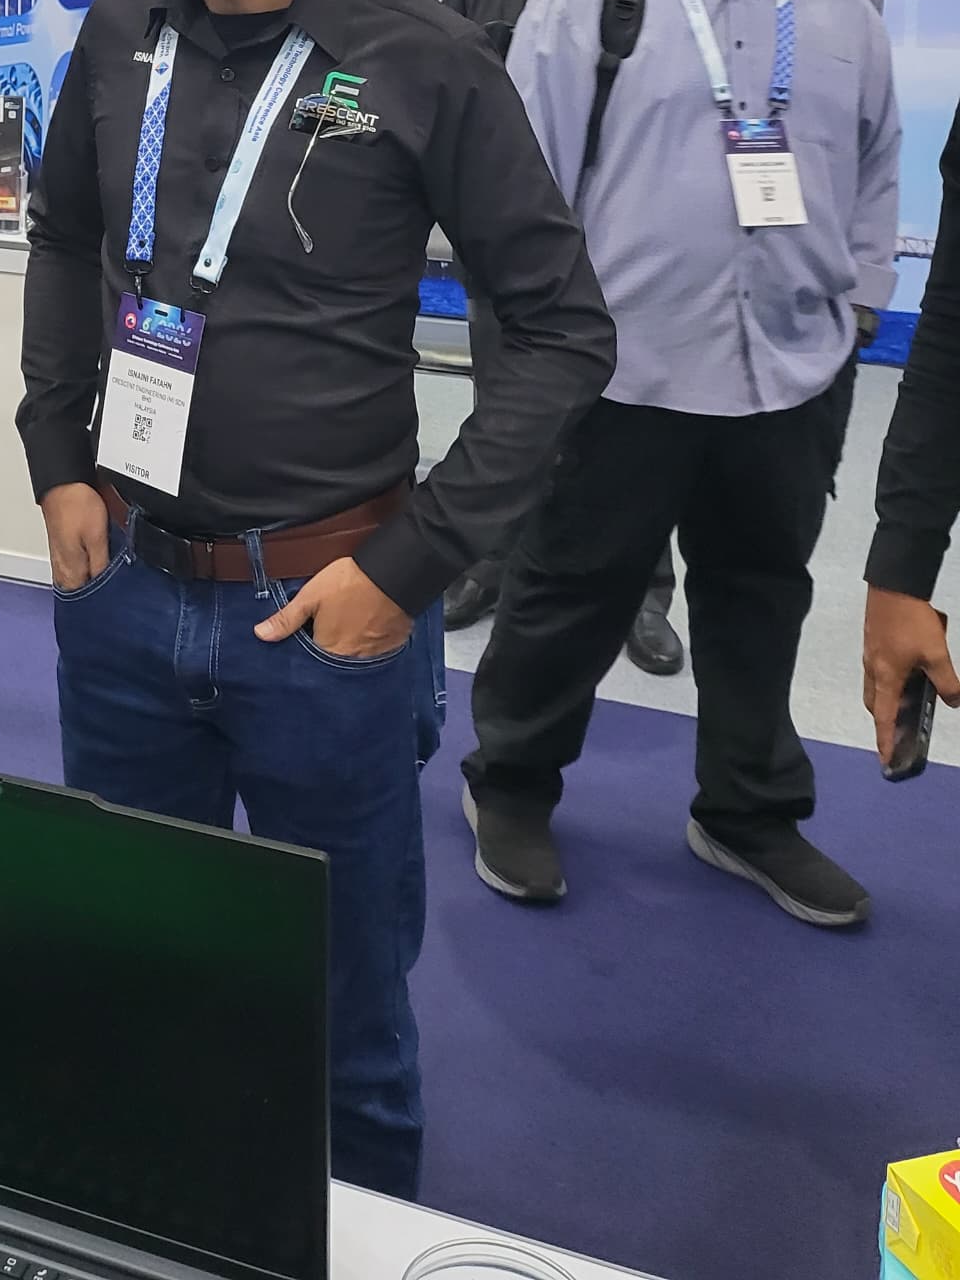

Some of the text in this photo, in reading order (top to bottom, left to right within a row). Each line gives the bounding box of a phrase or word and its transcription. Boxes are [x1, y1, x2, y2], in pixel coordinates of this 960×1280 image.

[279, 49, 304, 87] Technology
[259, 86, 283, 126] Conference
[295, 97, 380, 127] CRESCENT
[251, 125, 263, 142] Asia
[124, 461, 151, 481] VISITOR
